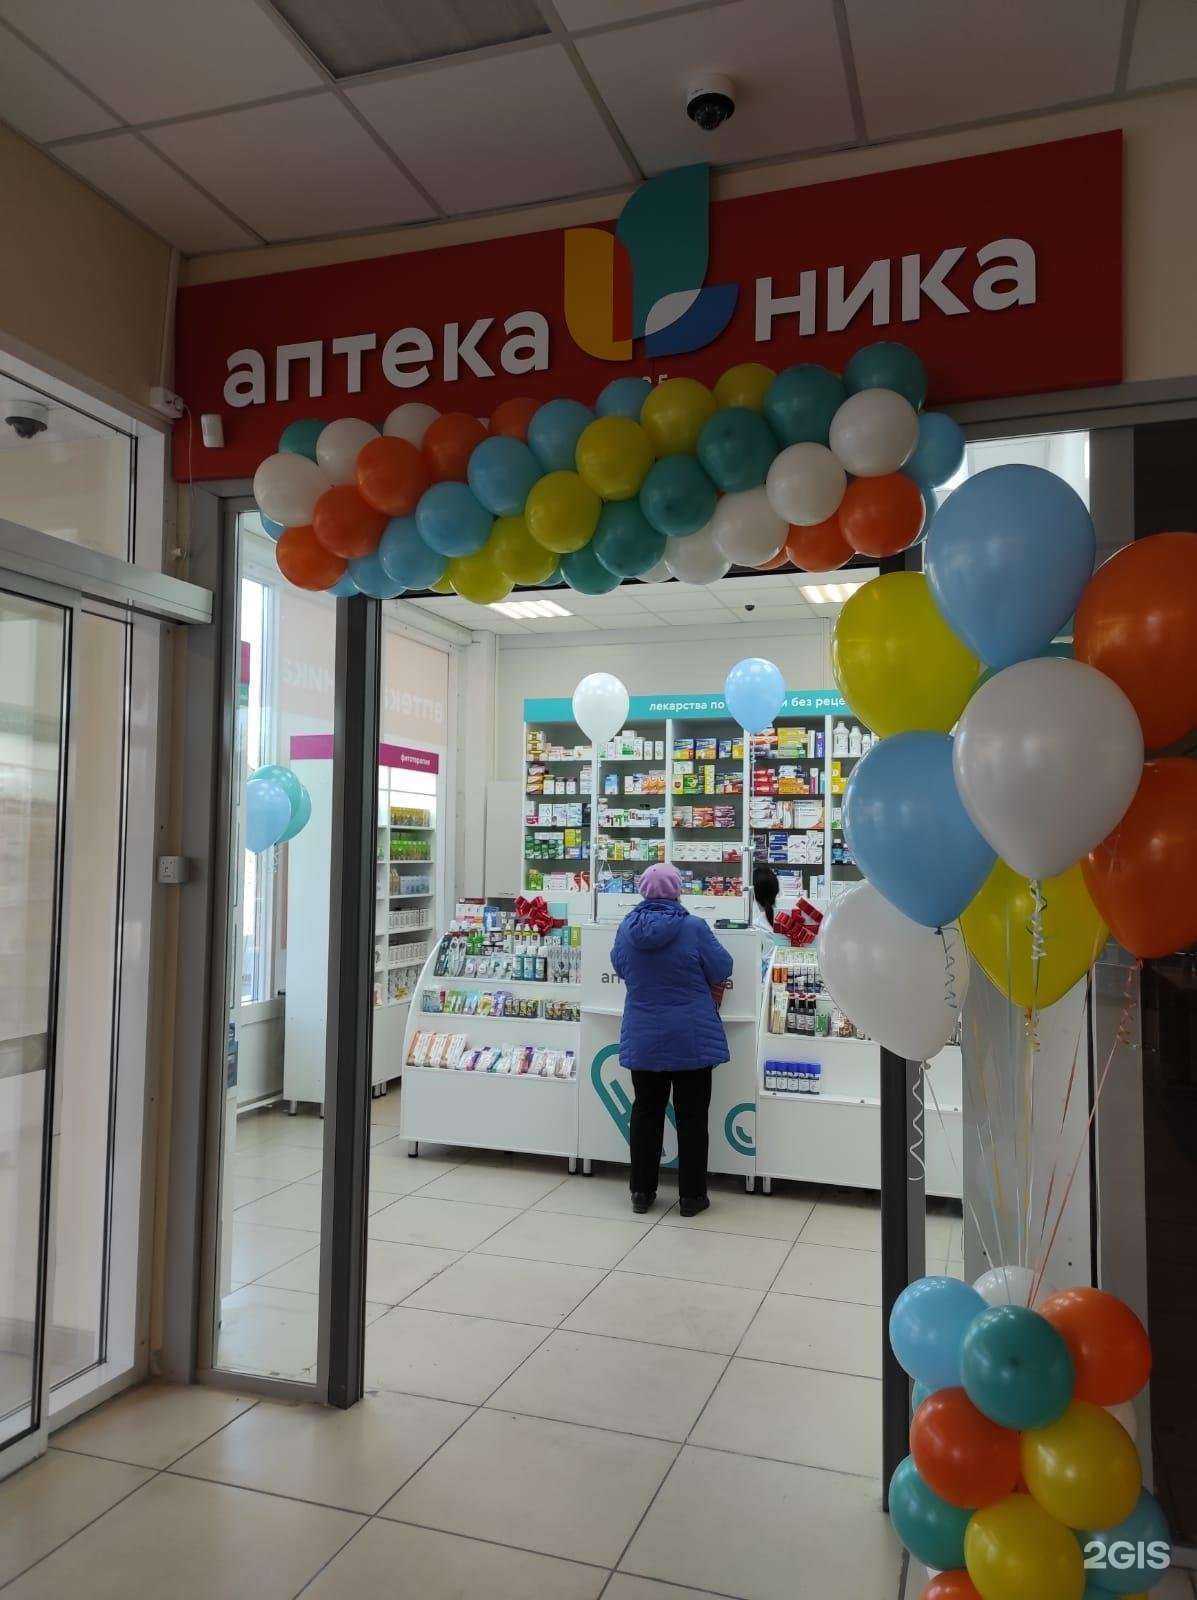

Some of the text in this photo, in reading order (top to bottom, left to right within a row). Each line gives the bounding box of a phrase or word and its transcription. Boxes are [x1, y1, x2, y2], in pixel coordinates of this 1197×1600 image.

[223, 238, 1037, 408] аптека ника
[649, 701, 708, 712] лекарства
[710, 701, 725, 710] по
[791, 697, 812, 707] без
[815, 697, 847, 709] реце
